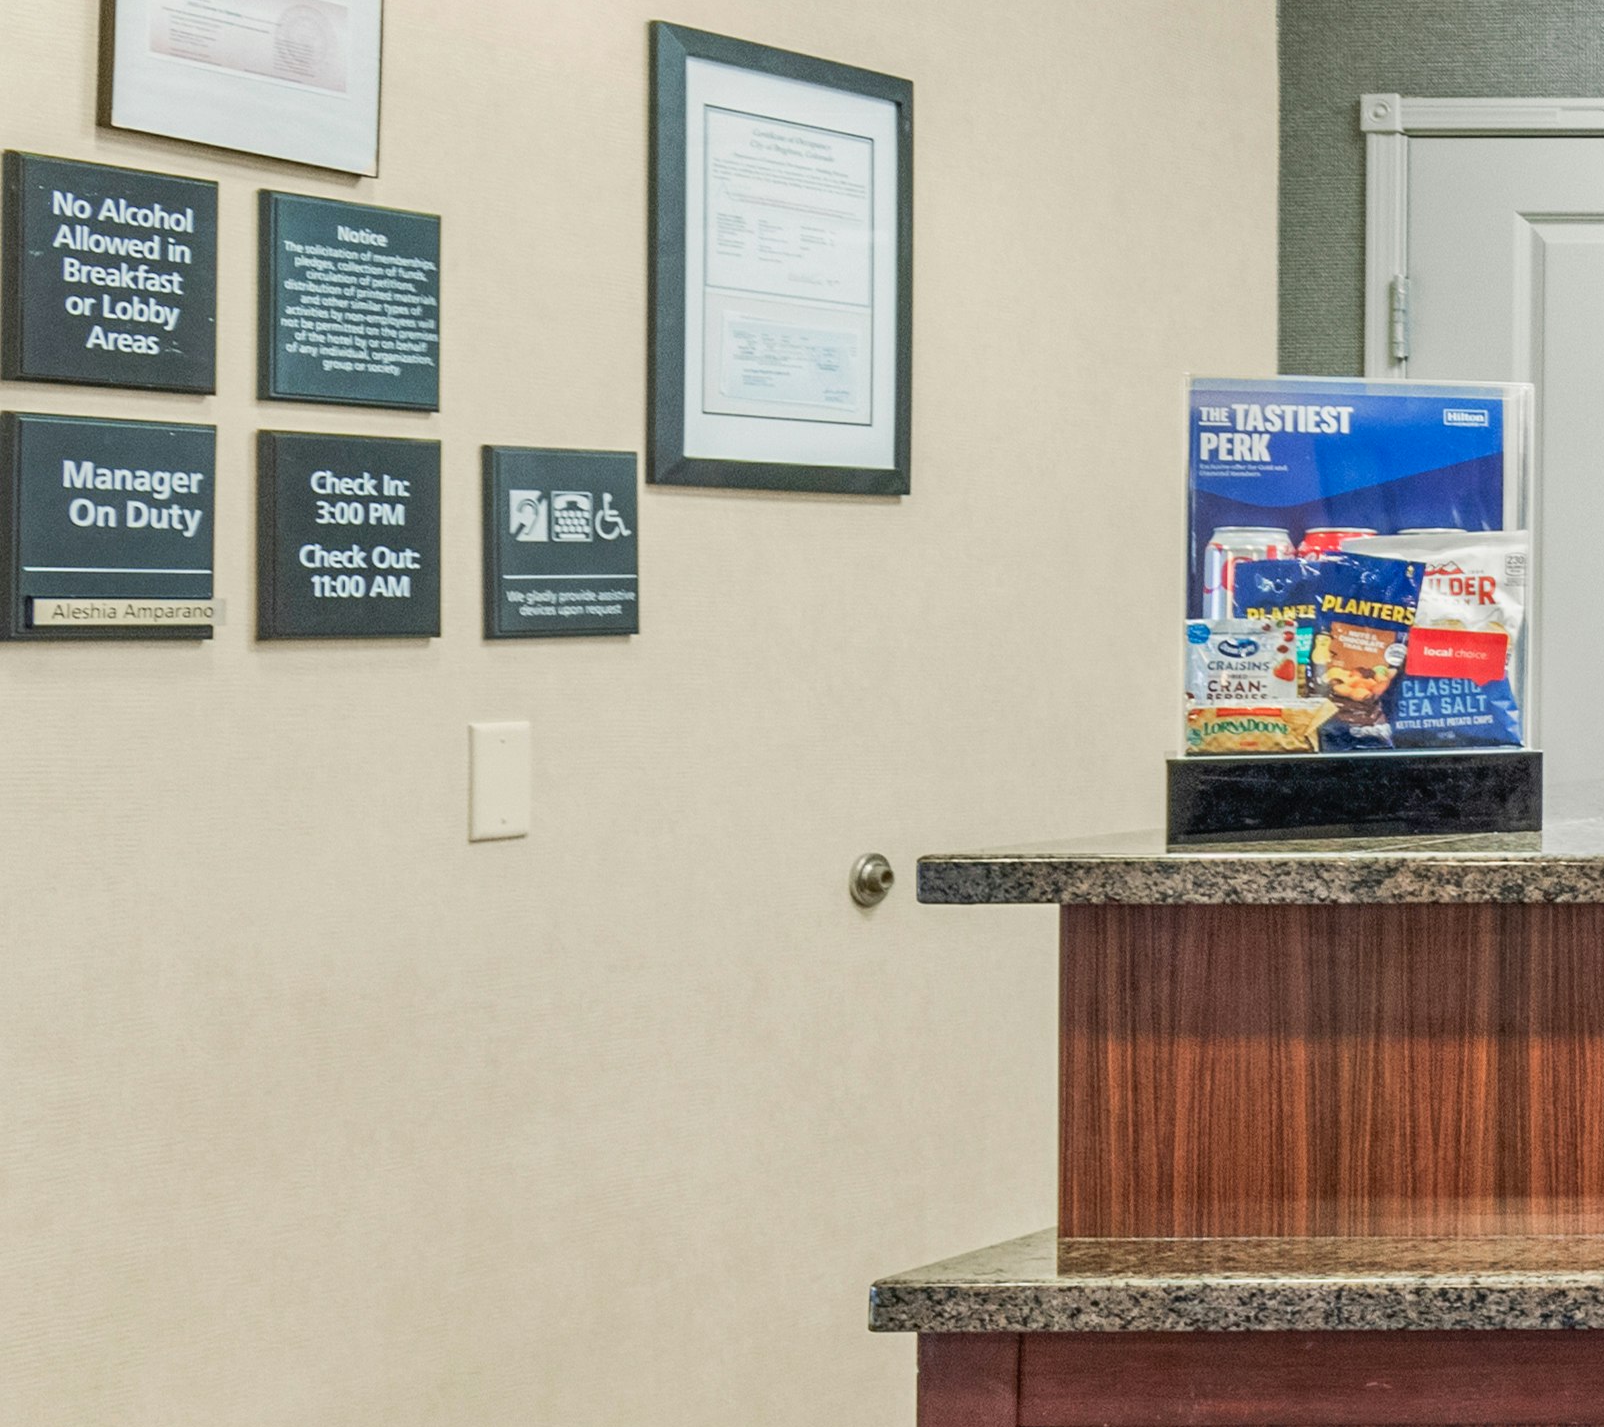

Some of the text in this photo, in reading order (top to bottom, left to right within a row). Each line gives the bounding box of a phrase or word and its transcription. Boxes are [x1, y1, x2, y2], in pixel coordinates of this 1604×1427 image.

[53, 190, 193, 233] No Alcohol
[53, 225, 191, 264] Allowed in
[337, 225, 388, 248] Notice
[283, 240, 304, 253] The
[360, 250, 372, 261] of
[63, 257, 184, 295] Breakfast
[359, 275, 371, 285] of
[385, 266, 397, 277] of
[300, 295, 321, 306] and
[321, 297, 349, 308] other
[343, 285, 355, 296] of
[65, 294, 181, 331] or Lobby
[85, 325, 160, 355] Areas
[285, 341, 298, 353] of
[299, 345, 318, 357] any
[322, 359, 353, 372] group
[354, 363, 365, 371] or
[1199, 404, 1354, 434] THE TASTIEST
[1447, 411, 1484, 423] Hilton
[1200, 432, 1271, 462] PERK
[62, 460, 204, 499] Manager
[310, 470, 411, 497] Check In:
[69, 498, 203, 537] On Duty
[315, 501, 405, 525] 3:00 PM
[299, 544, 421, 569] Check Out:
[311, 575, 411, 598] 11:00 AM
[506, 589, 636, 605] We gladly provide assistive
[52, 604, 214, 624] Aleshia Amparano
[519, 604, 623, 618] devices upon request
[1321, 594, 1416, 625] PLANTERS
[1423, 646, 1453, 658] local
[1207, 660, 1270, 671] CRAISINS
[1398, 695, 1487, 717] SEA SALT
